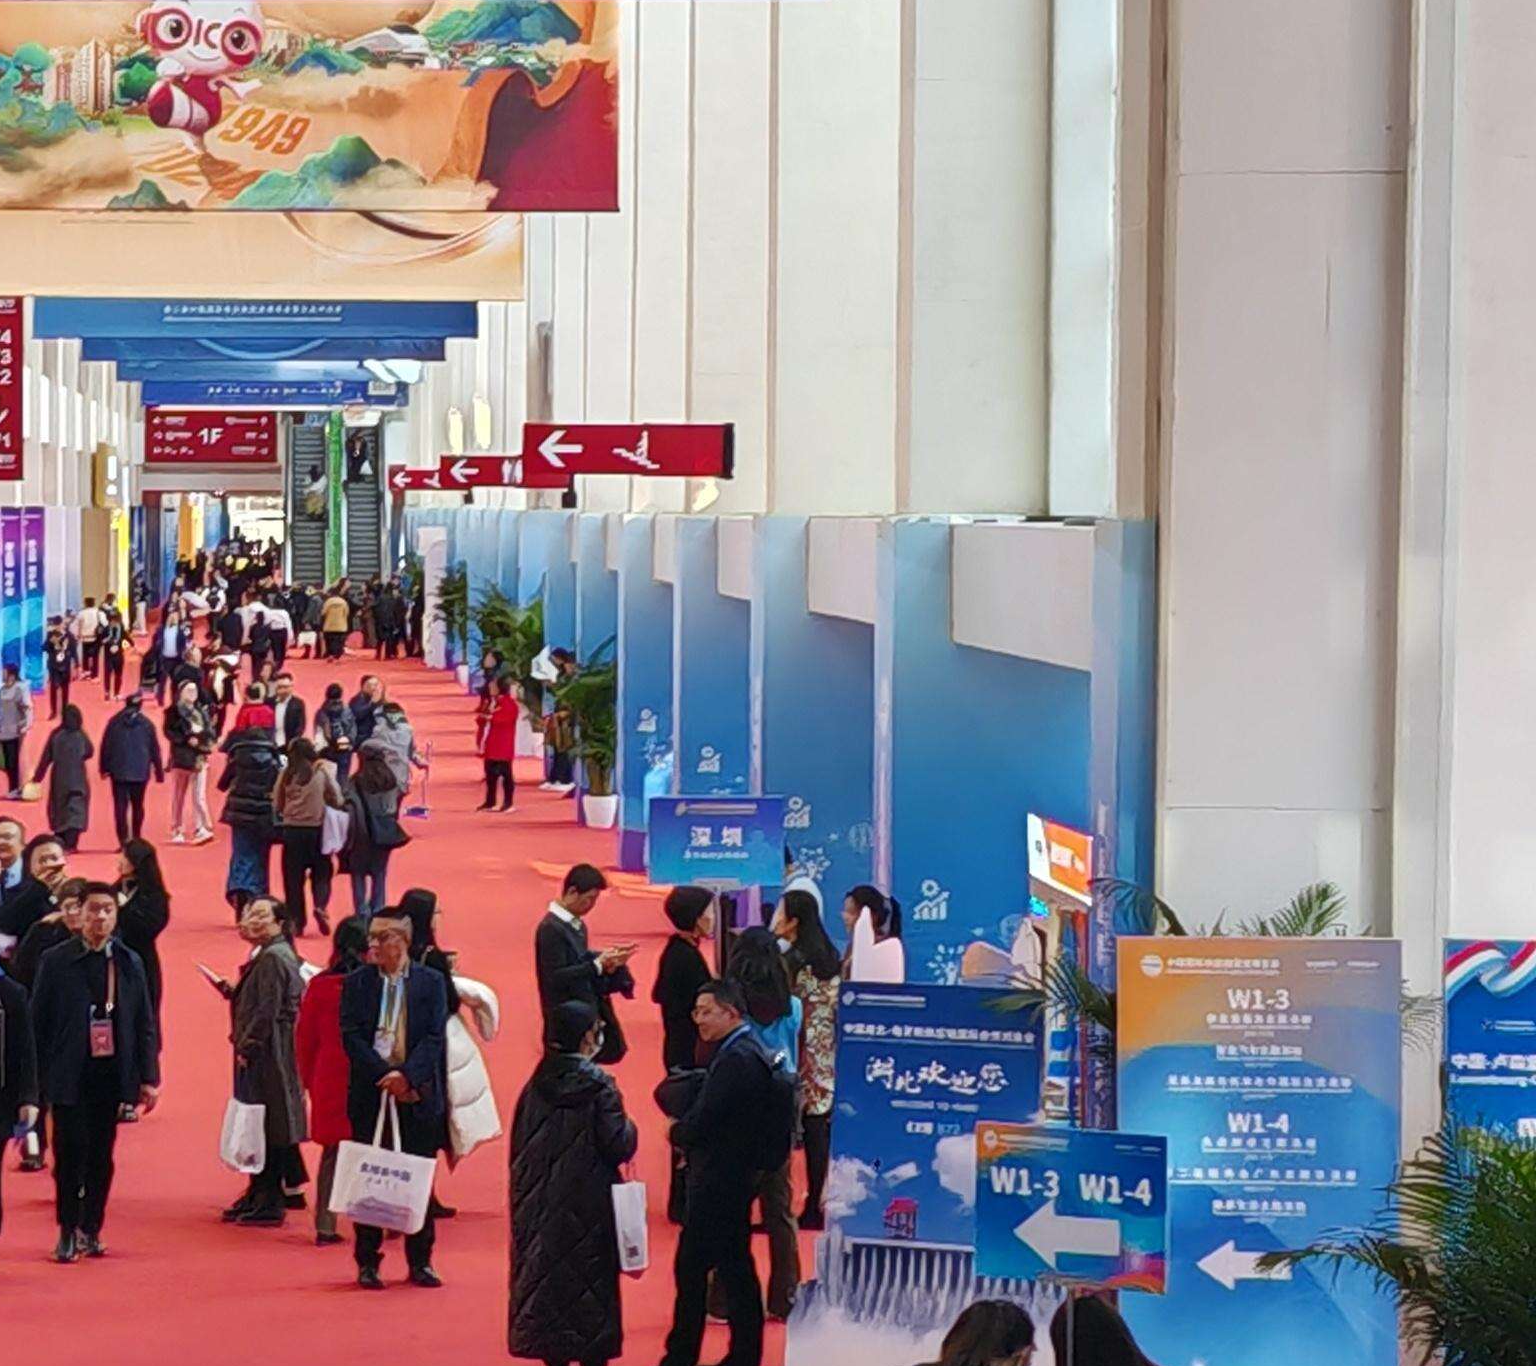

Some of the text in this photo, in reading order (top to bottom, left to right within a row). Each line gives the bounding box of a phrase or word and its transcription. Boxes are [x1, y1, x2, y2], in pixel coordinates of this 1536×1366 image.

[1226, 988, 1291, 1011] W1-3
[1227, 1111, 1290, 1133] W1-4
[990, 1165, 1060, 1199] W1-3
[1078, 1173, 1152, 1207] W1-4
